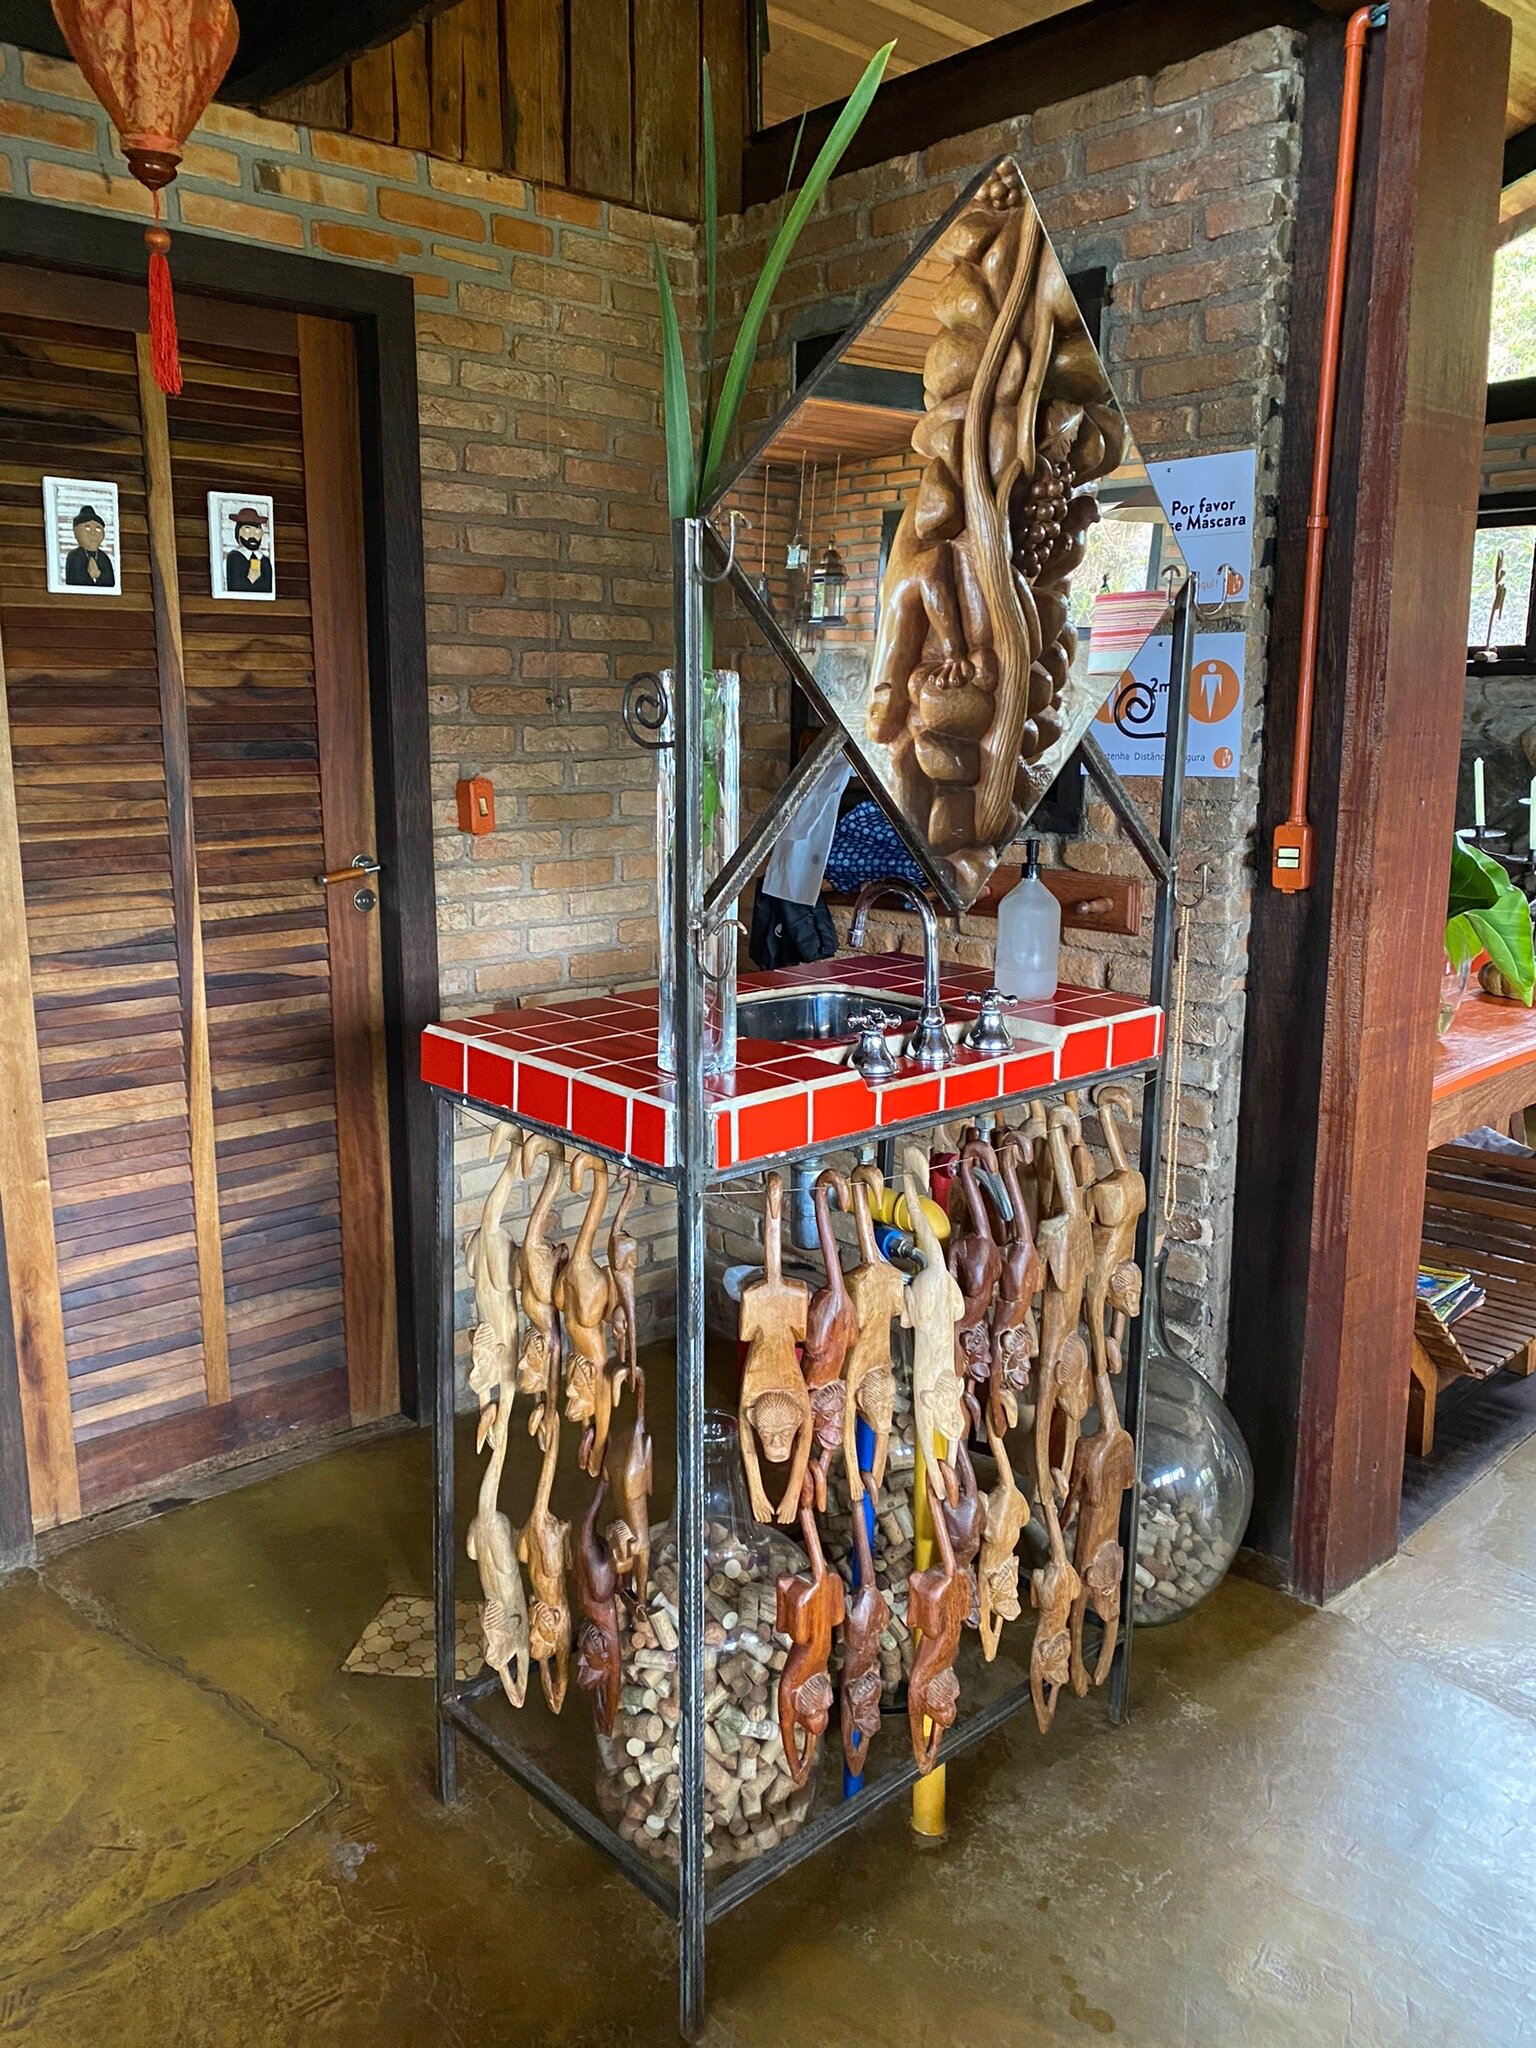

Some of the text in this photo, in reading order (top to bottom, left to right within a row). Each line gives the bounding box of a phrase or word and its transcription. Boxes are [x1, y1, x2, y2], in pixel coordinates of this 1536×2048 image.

[1172, 497, 1236, 516] Por favor
[1170, 513, 1246, 532] se Máscara
[1199, 578, 1219, 589] qui!
[1105, 752, 1206, 763] tenha Distânc gura
